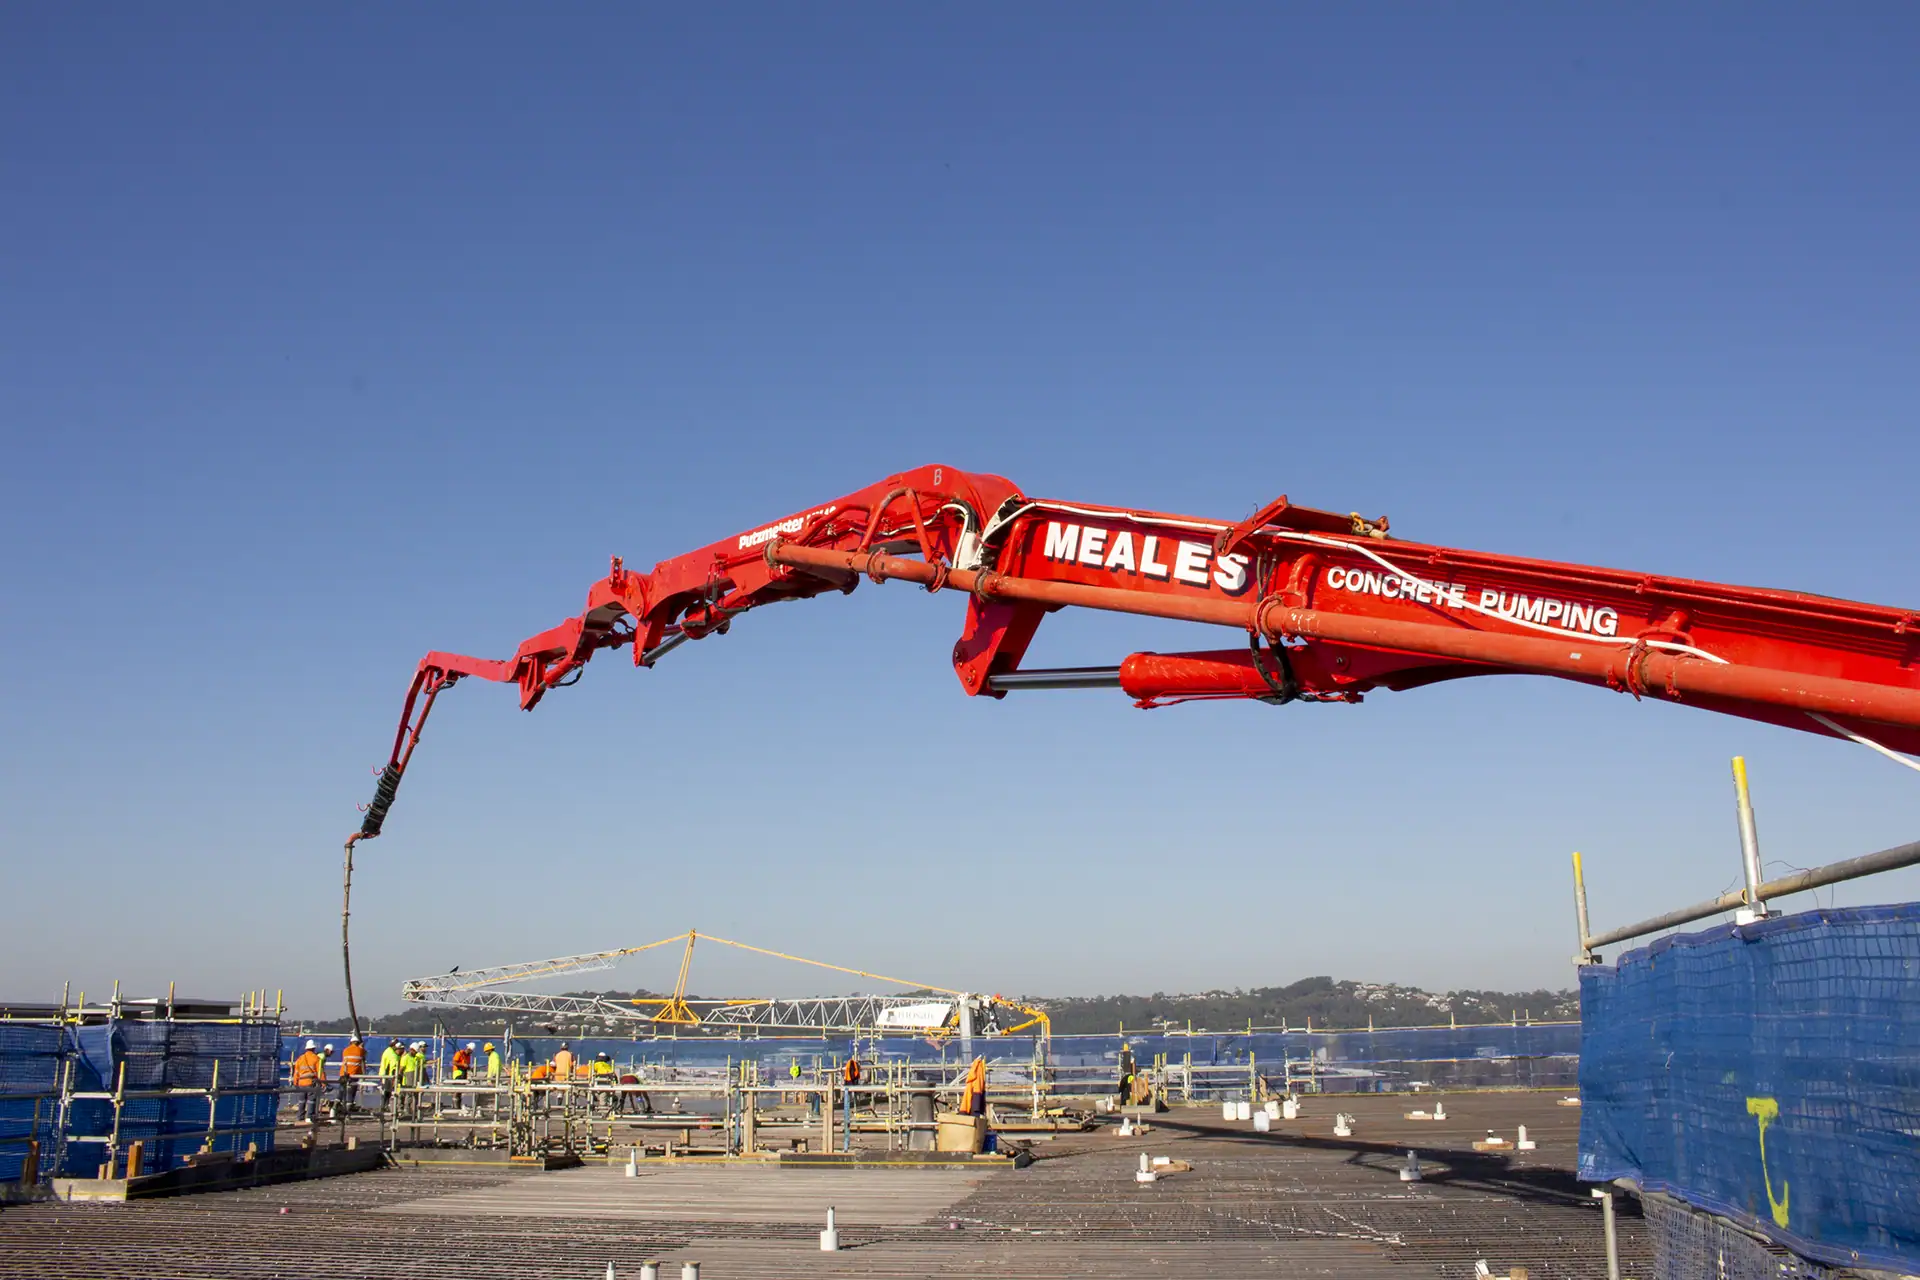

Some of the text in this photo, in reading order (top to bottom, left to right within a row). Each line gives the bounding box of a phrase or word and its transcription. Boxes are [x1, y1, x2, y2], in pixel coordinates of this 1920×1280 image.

[1044, 521, 1249, 591] MEALES
[1327, 566, 1618, 636] CONCRETE PUMPING
